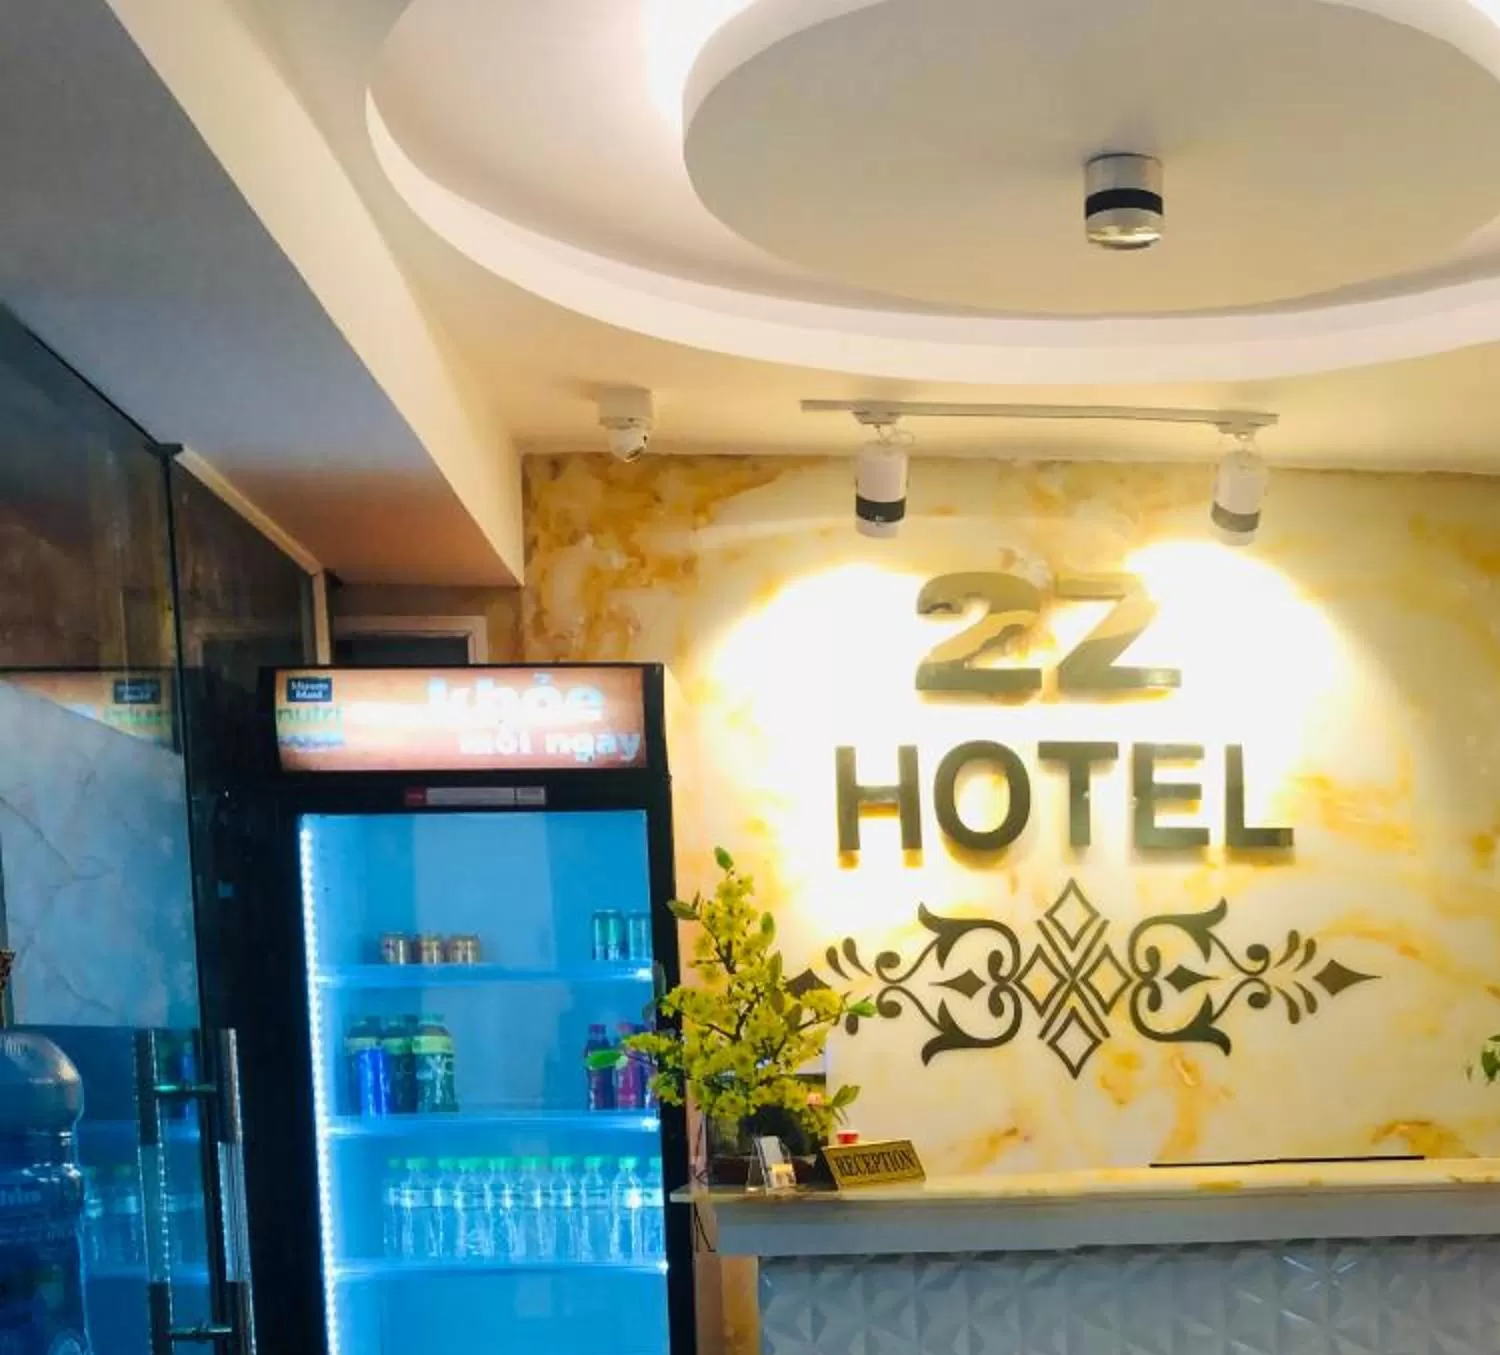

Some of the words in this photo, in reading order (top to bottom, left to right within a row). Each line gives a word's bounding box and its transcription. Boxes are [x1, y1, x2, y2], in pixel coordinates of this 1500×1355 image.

[915, 571, 1182, 691] 2Z
[835, 740, 1295, 851] HOTEL
[833, 1149, 916, 1177] RECEPTION
